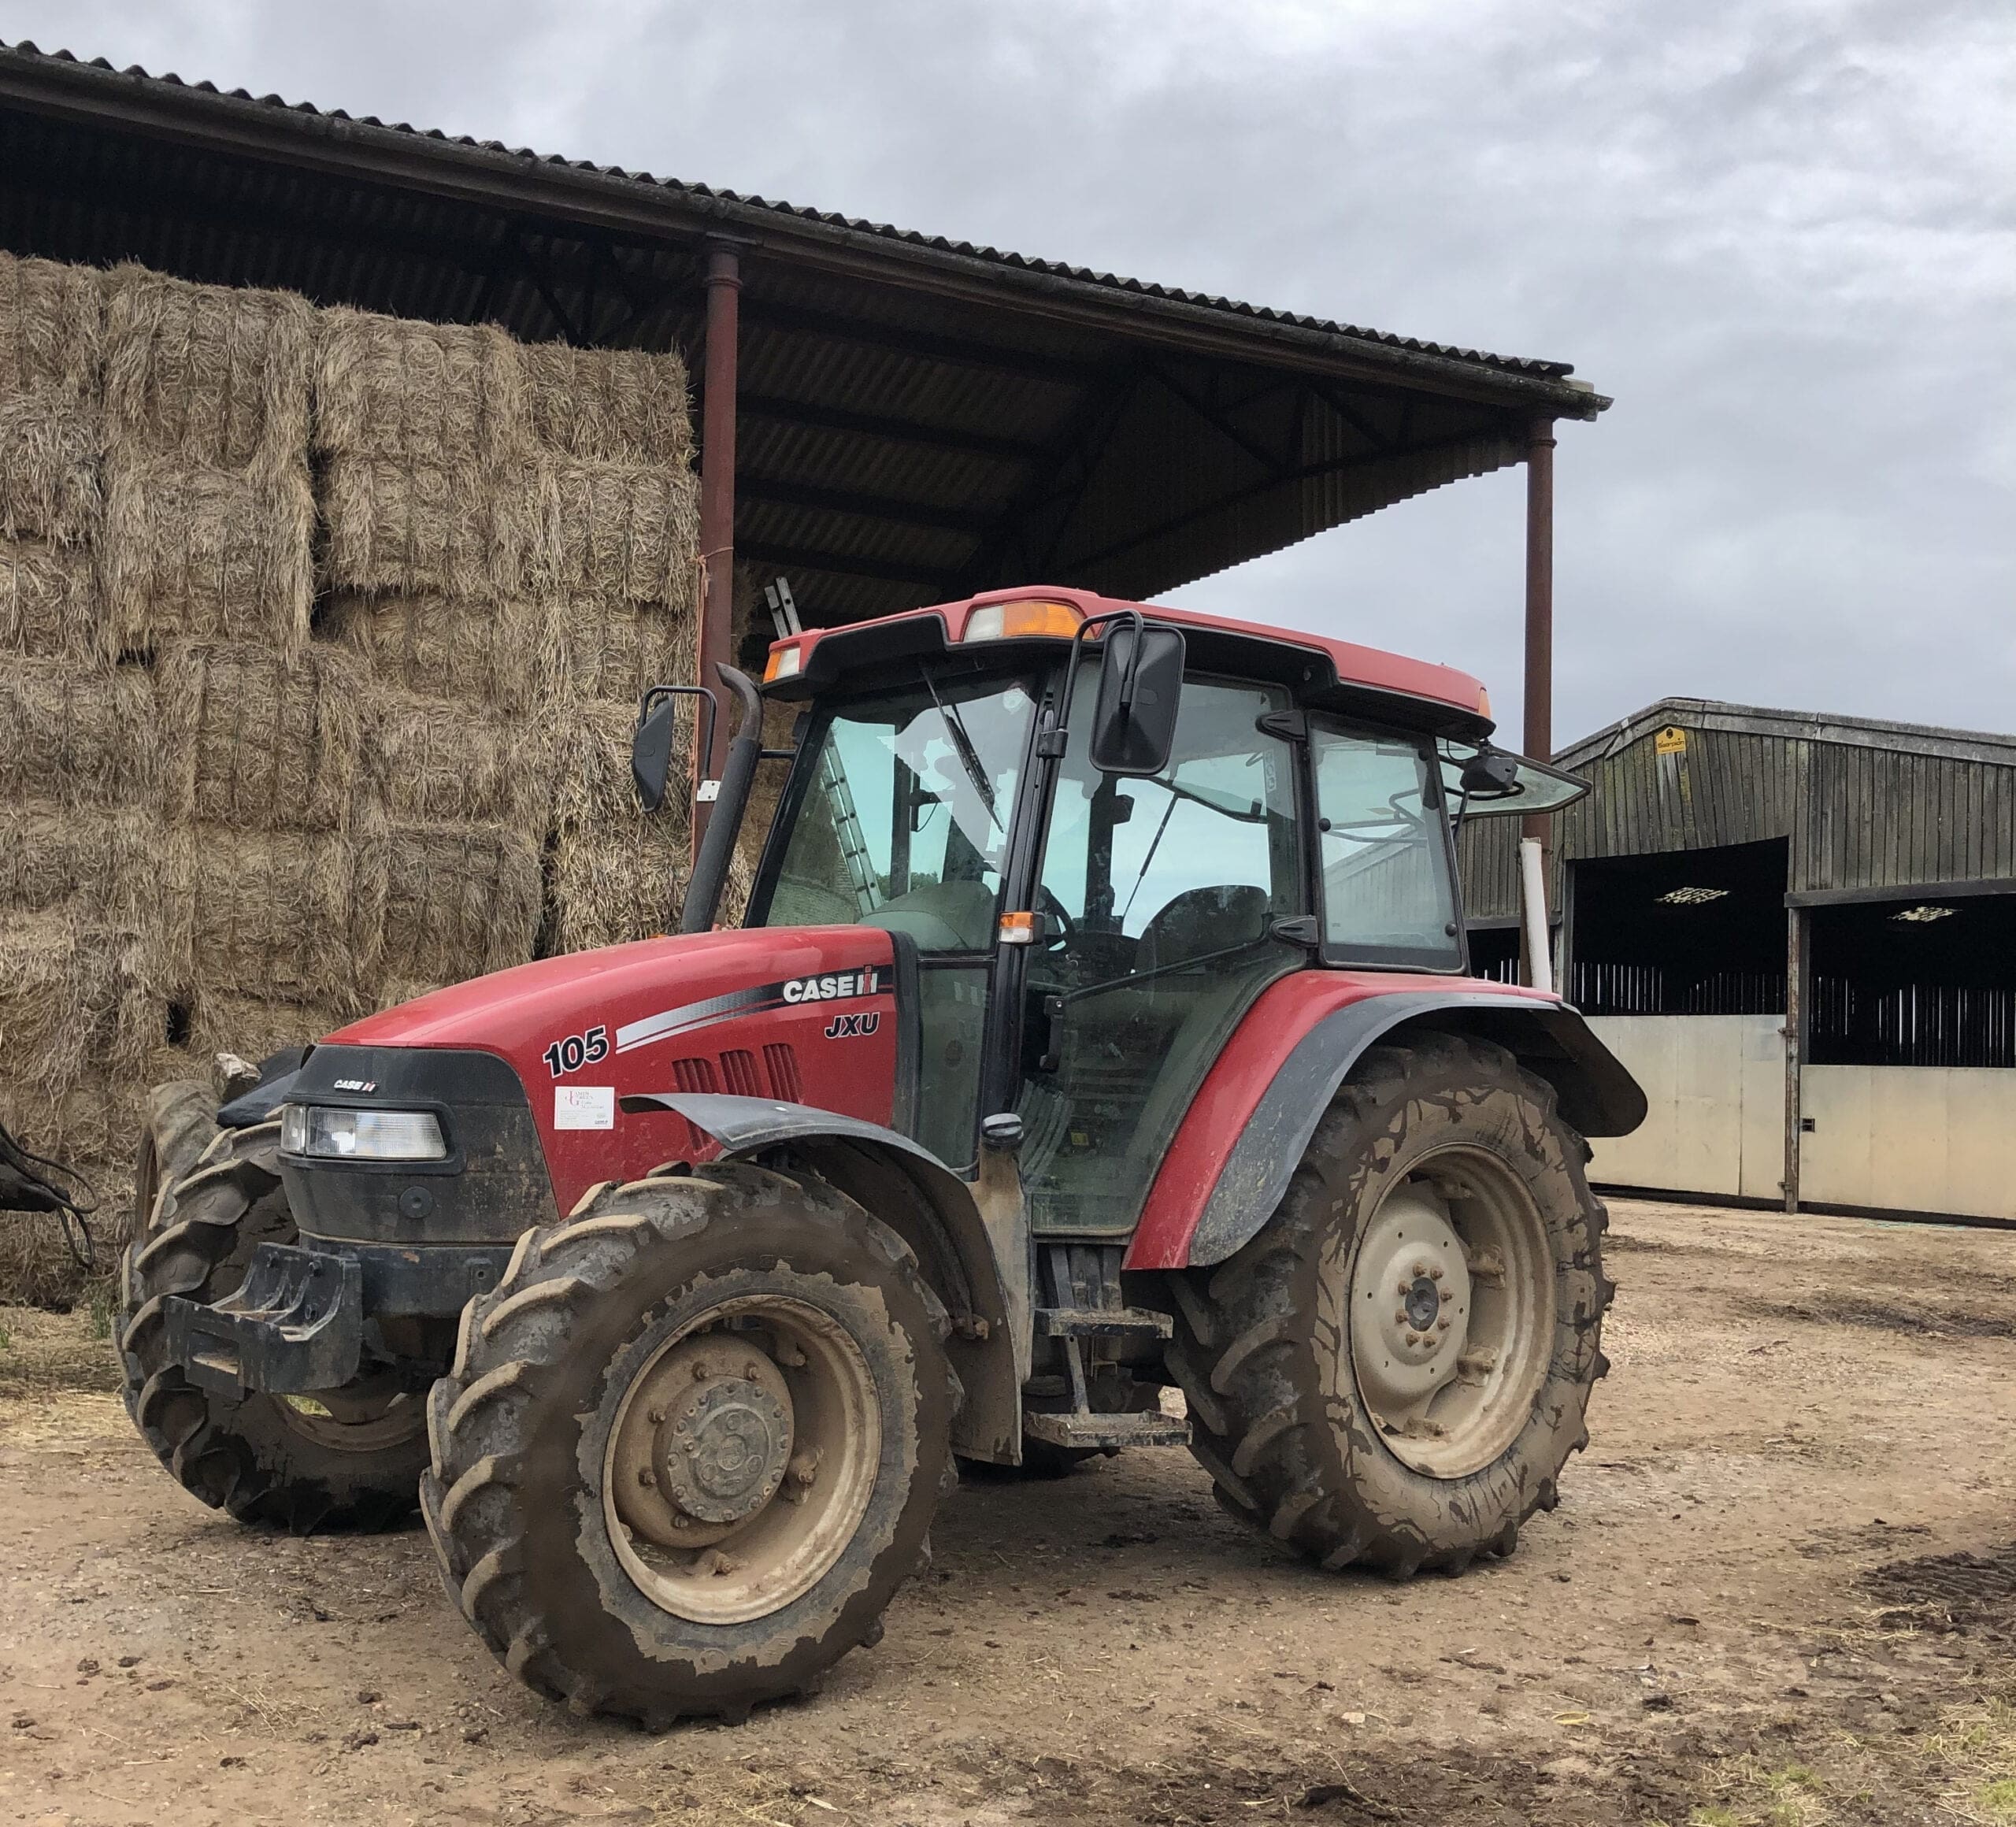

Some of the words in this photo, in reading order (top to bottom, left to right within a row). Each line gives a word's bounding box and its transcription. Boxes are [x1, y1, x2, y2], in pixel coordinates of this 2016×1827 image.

[783, 975, 854, 1003] CASE
[825, 1011, 880, 1040] JXU
[543, 1025, 610, 1079] 105
[333, 1079, 364, 1090] CASE
